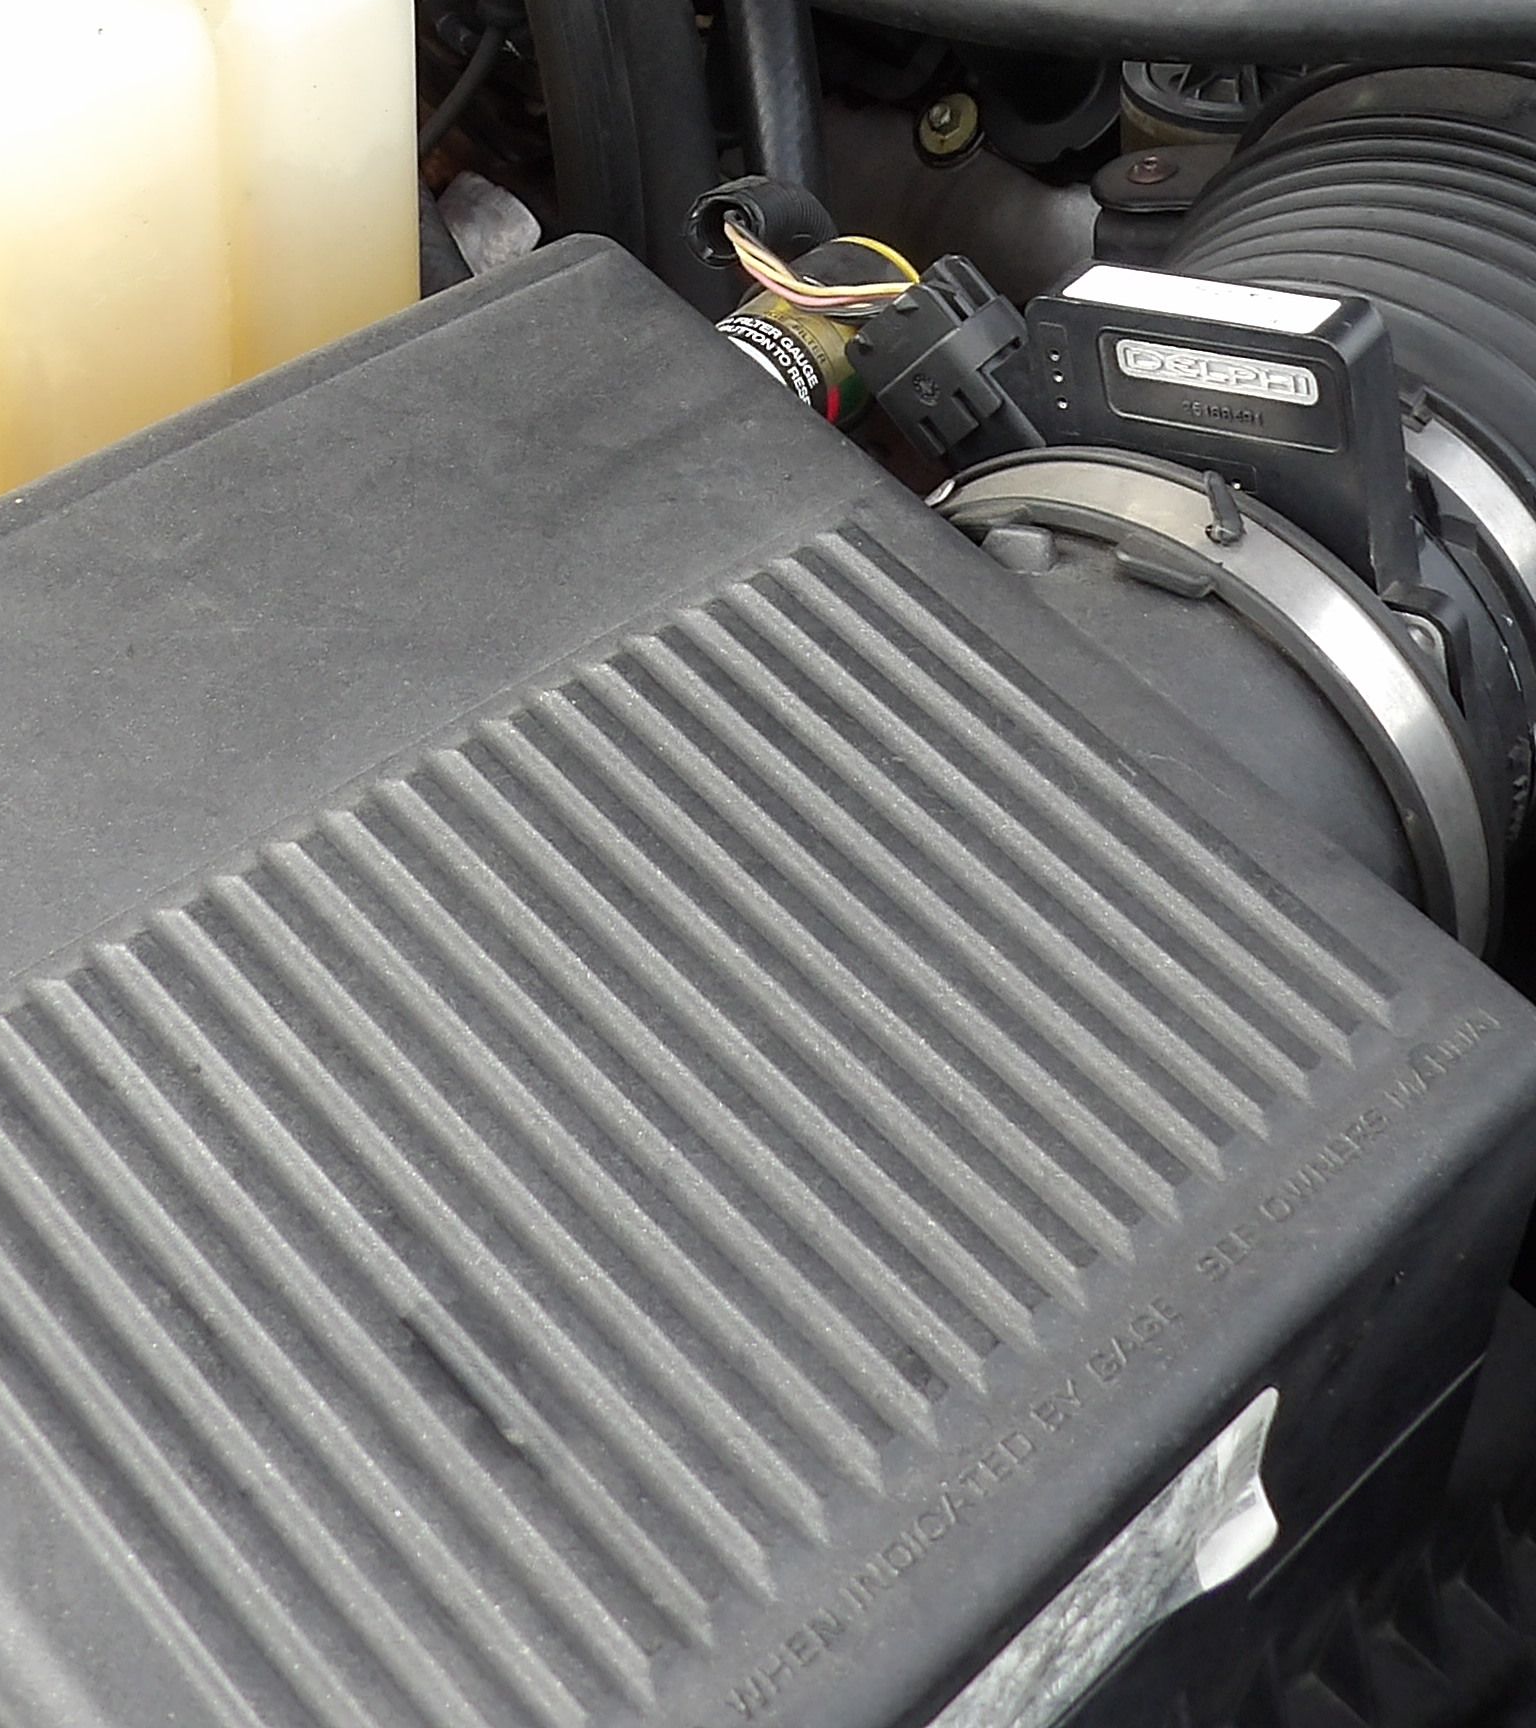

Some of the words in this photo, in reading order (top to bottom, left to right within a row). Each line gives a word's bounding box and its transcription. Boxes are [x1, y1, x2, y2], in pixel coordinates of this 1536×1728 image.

[773, 345, 792, 368] TO
[780, 336, 820, 390] GAUGE
[1123, 346, 1312, 398] DELPHI
[724, 1605, 847, 1723] WHEN
[840, 1429, 1037, 1609] INDICATED
[1029, 1377, 1084, 1433] BY
[1086, 1296, 1183, 1384] GAGE
